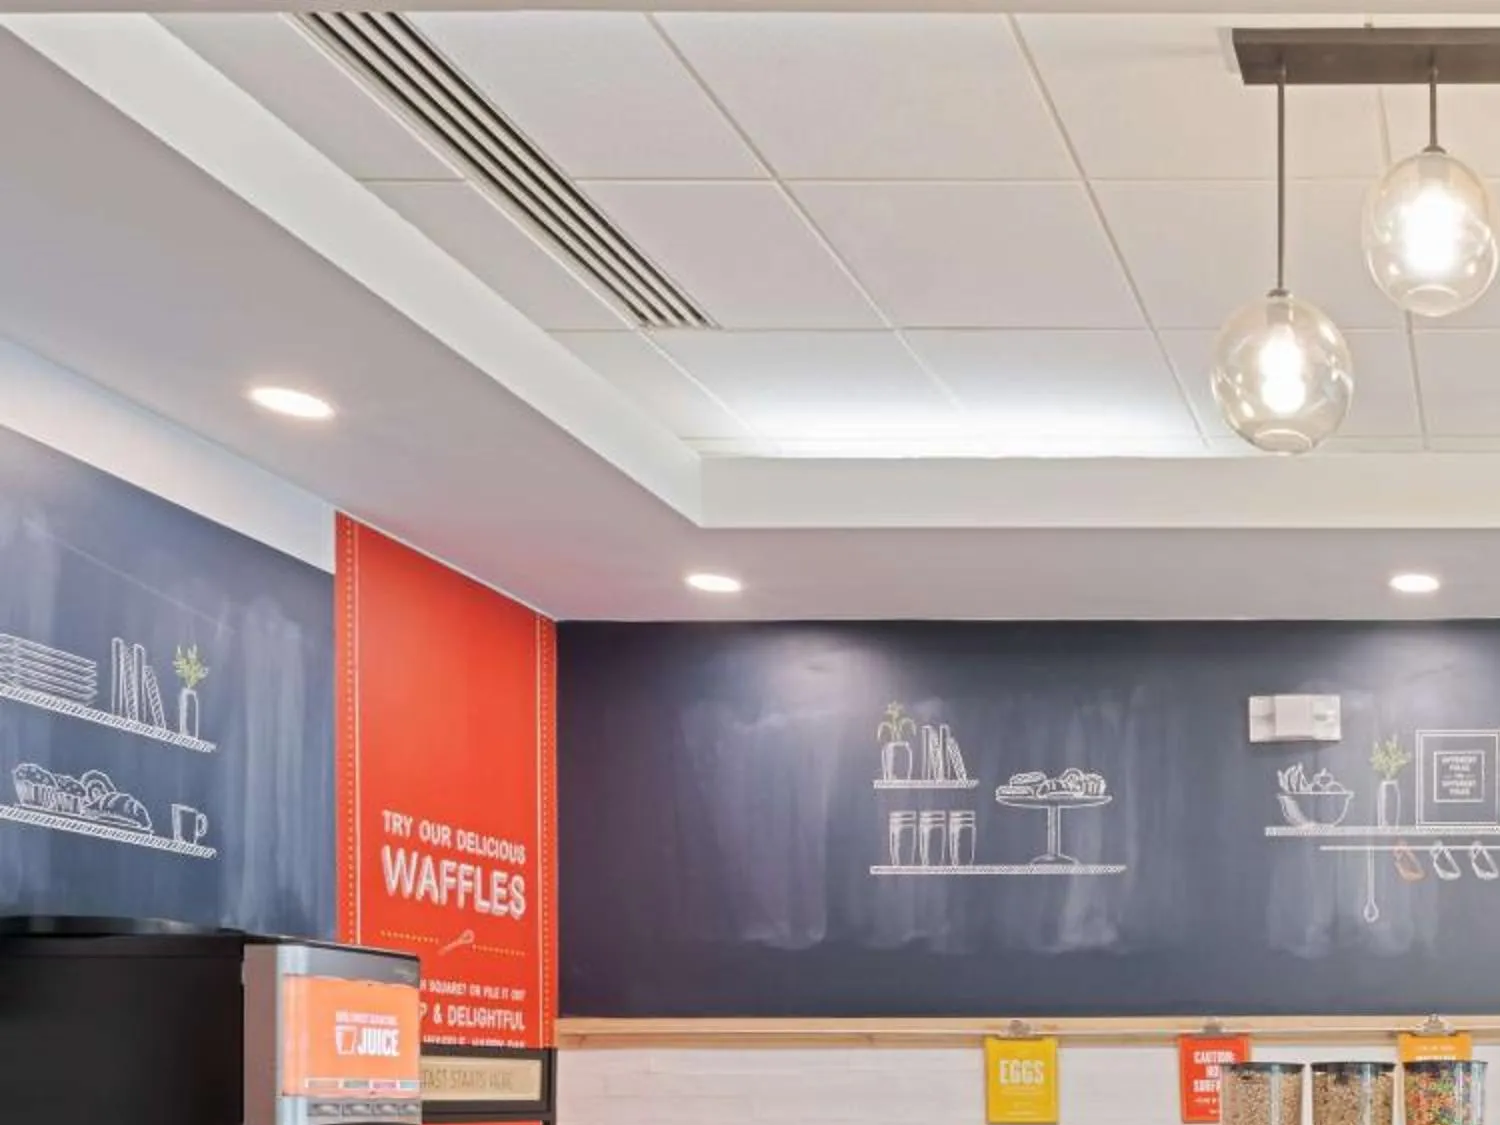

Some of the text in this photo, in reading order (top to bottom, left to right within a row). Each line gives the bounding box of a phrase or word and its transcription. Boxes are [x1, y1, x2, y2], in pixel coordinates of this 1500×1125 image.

[382, 809, 526, 864] TRY OUR DELICIOUS
[381, 844, 526, 920] WAFFLES
[433, 1002, 443, 1024] &
[447, 1004, 526, 1031] DELIGHTFUL
[358, 1027, 400, 1057] JUICE
[999, 1059, 1045, 1085] EGGS
